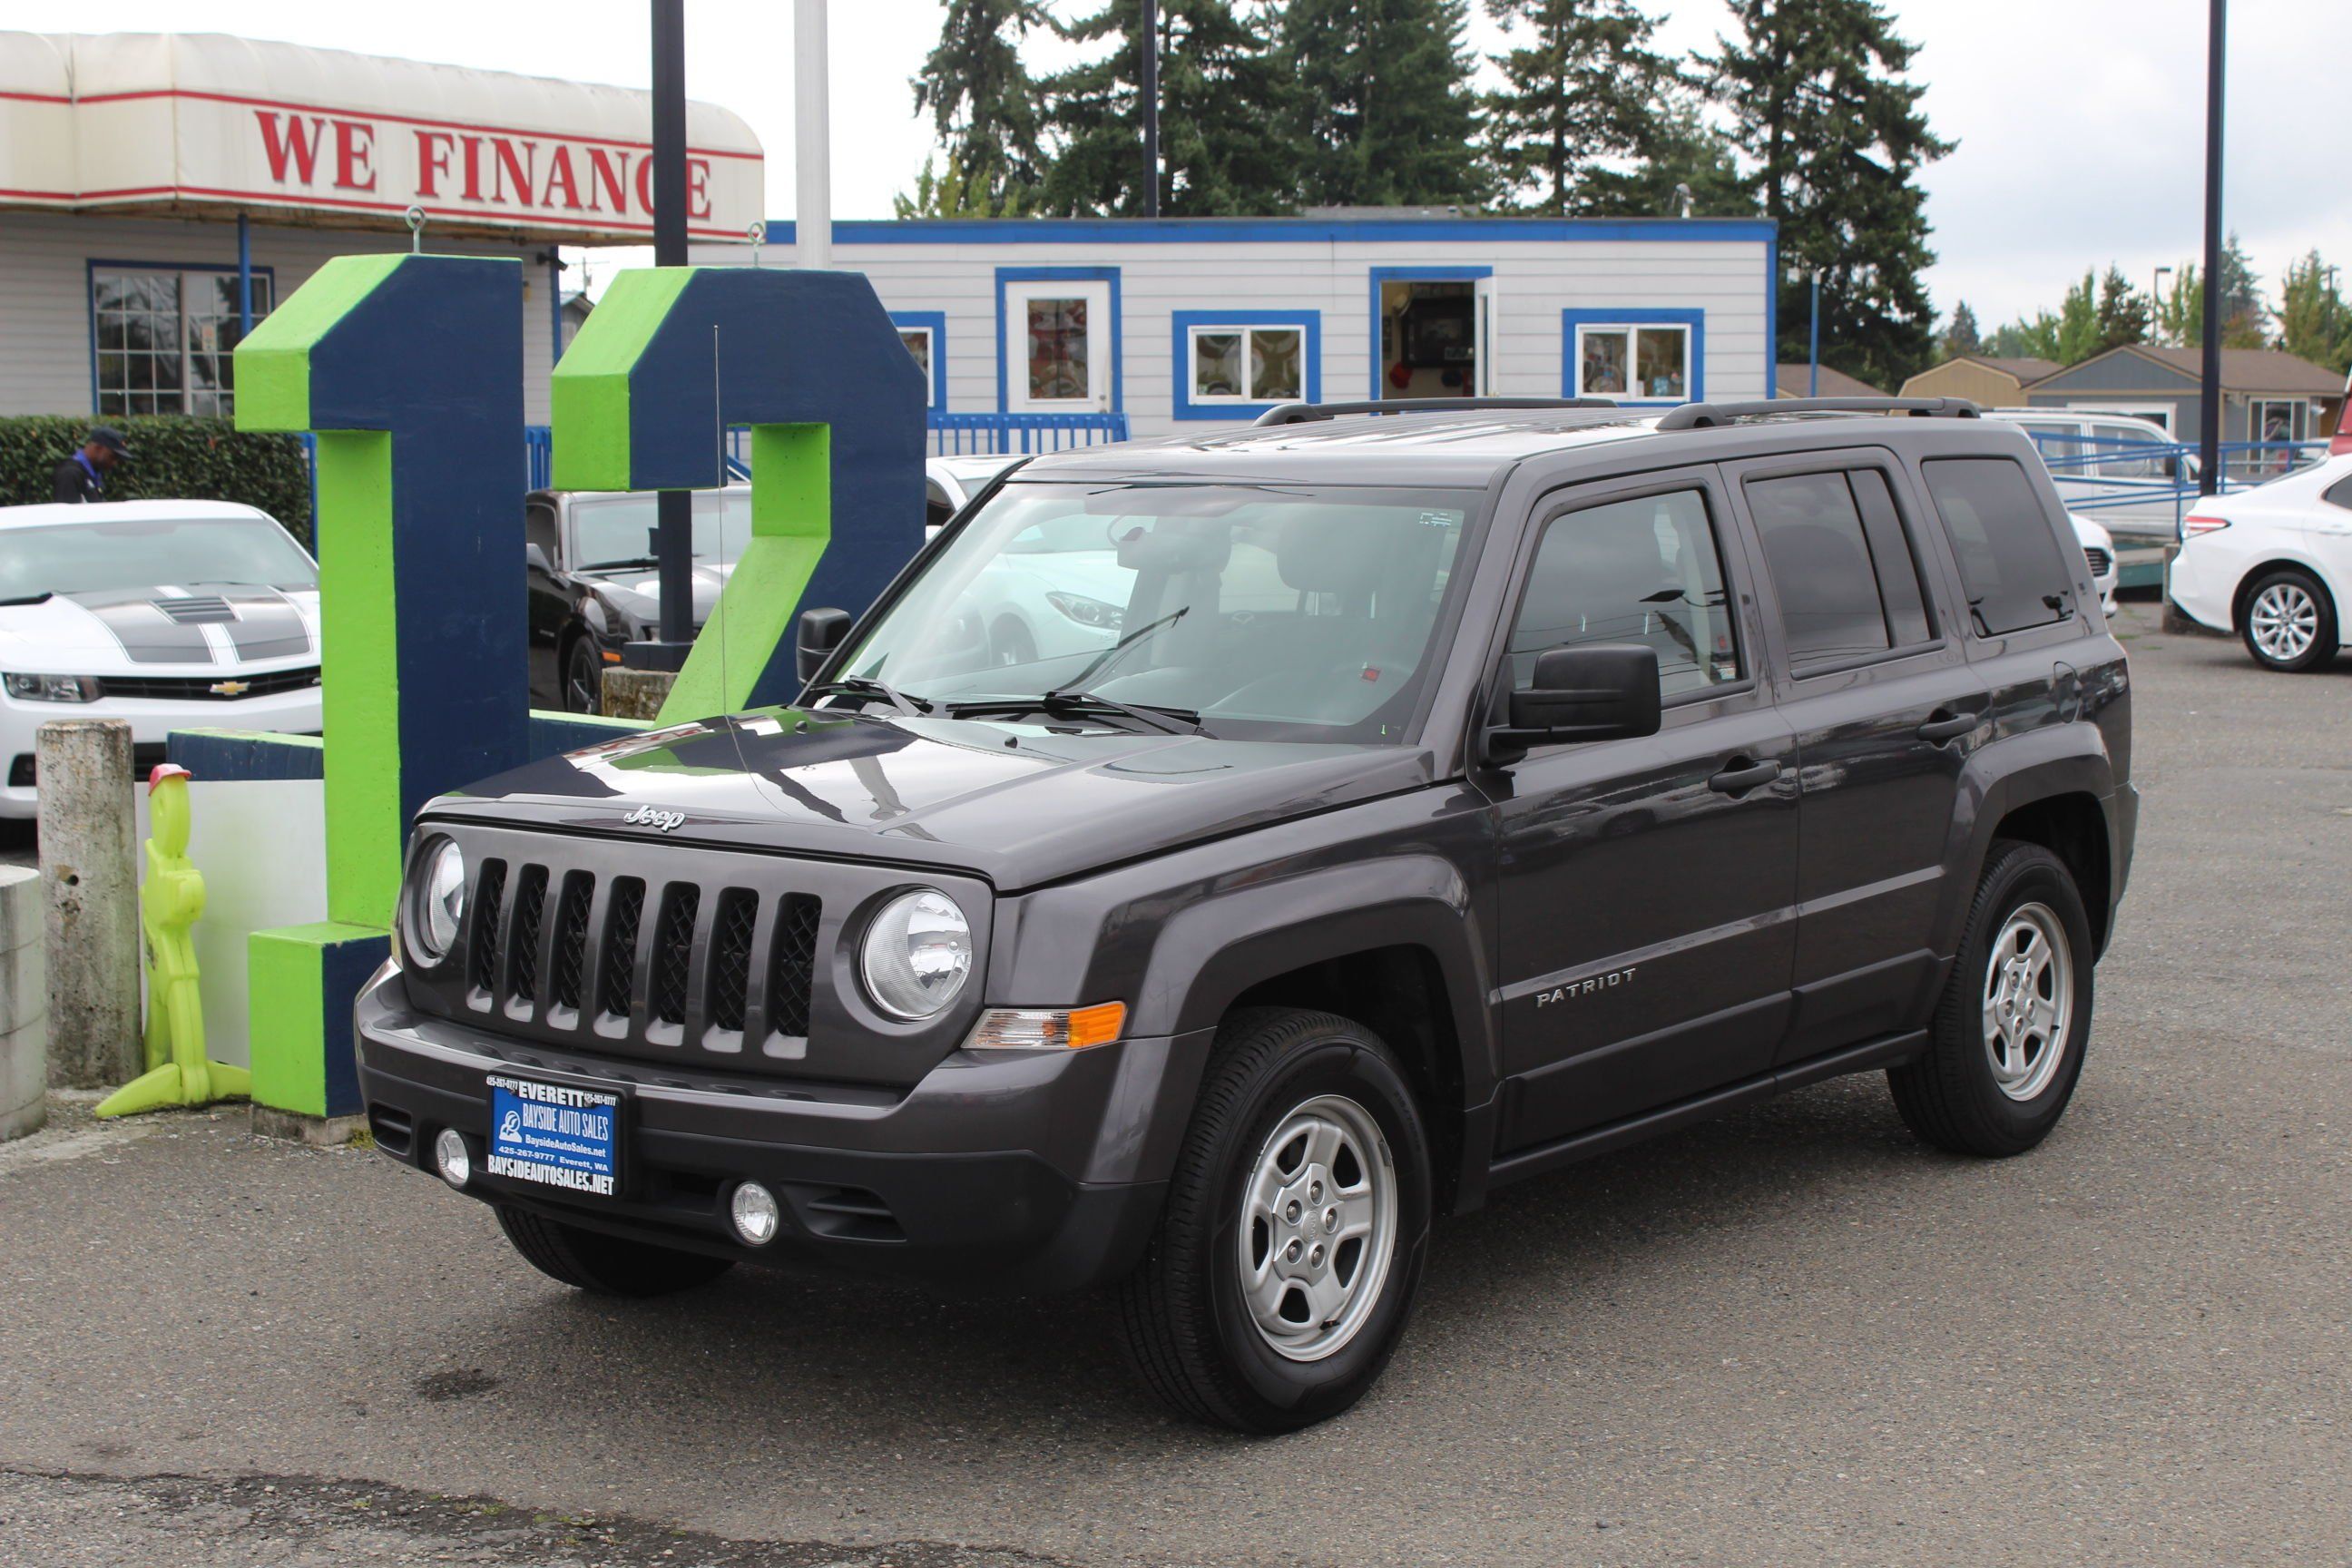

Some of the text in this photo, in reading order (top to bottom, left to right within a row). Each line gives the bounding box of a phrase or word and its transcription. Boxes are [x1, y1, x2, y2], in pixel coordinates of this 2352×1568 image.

[253, 109, 377, 192] WE
[623, 804, 685, 832] Jeep
[1536, 967, 1636, 1008] PATRIOT
[518, 1081, 584, 1108] EVERETT
[523, 1102, 608, 1142] BAYSIDE AUTO SALES
[498, 1145, 609, 1171] 425-267-9777 Everett, WA
[525, 1133, 606, 1158] BaysideAutoSales.net
[487, 1153, 614, 1196] BAYSIDEAUTOSALES.NET
